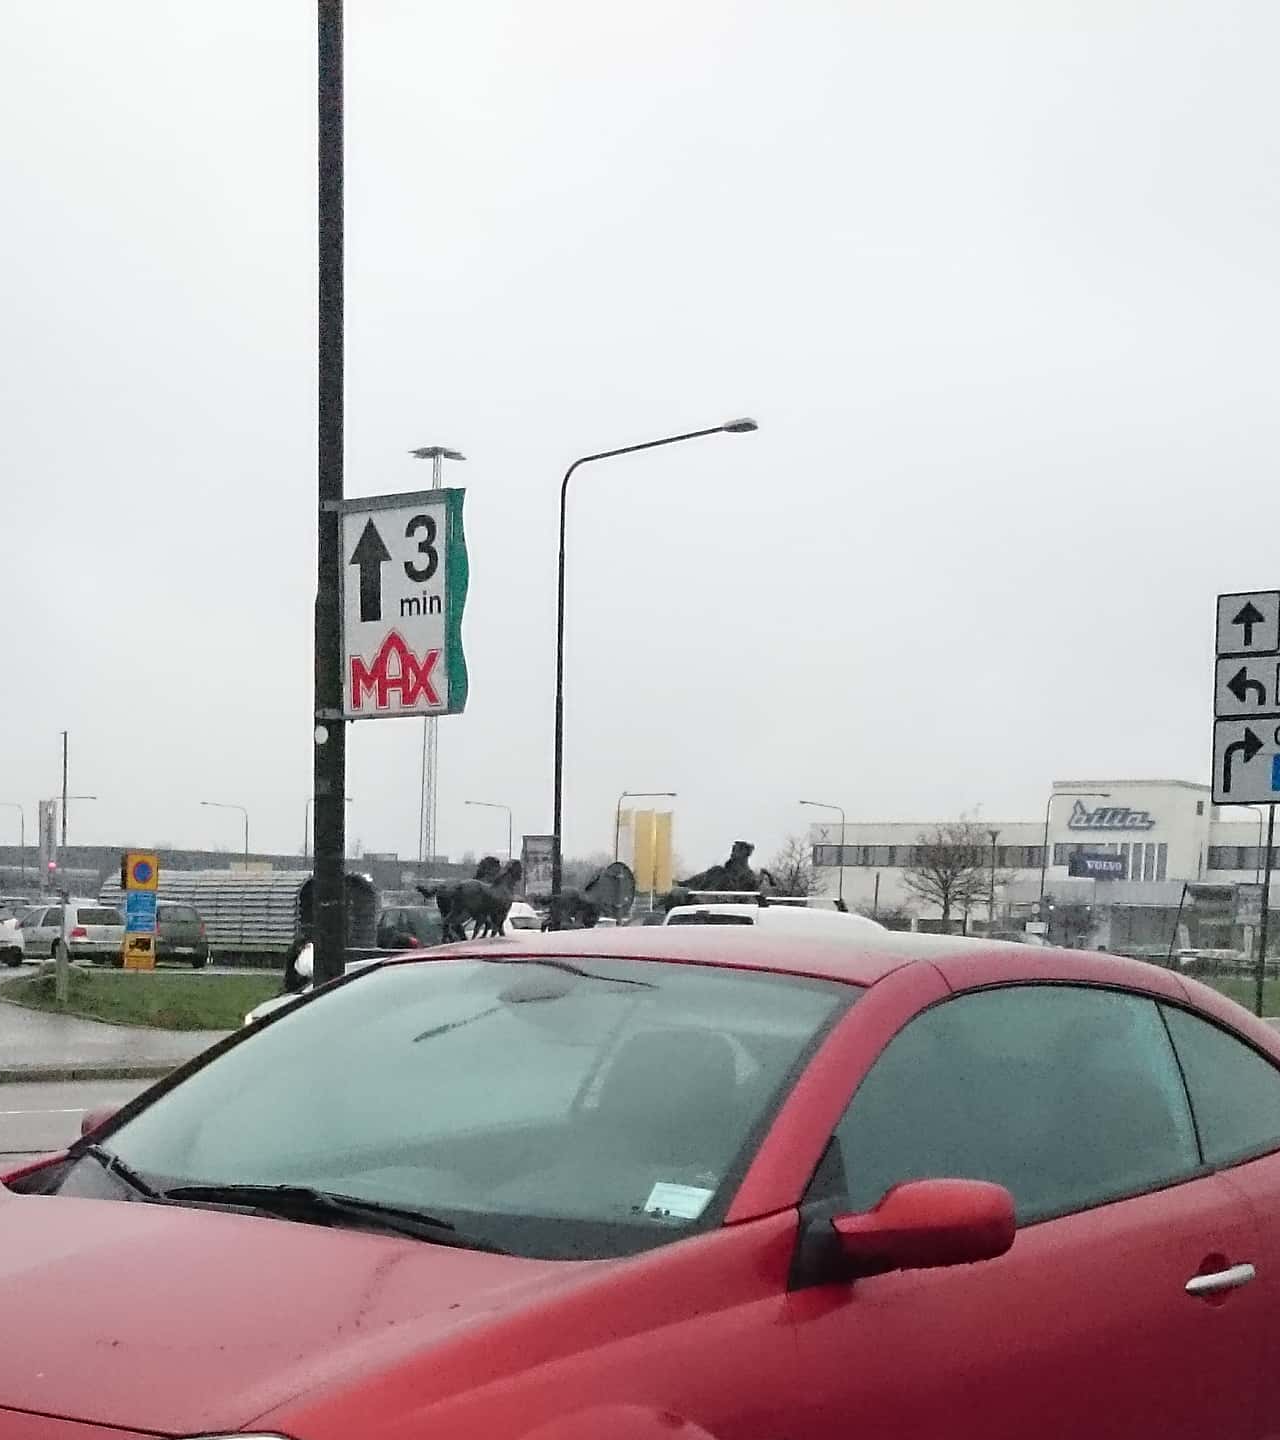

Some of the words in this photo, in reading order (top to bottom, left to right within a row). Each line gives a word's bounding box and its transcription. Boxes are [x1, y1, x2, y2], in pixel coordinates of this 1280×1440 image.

[404, 514, 439, 583] 3
[400, 591, 442, 617] min
[349, 627, 443, 711] MAX
[1086, 860, 1122, 871] VOLVO
